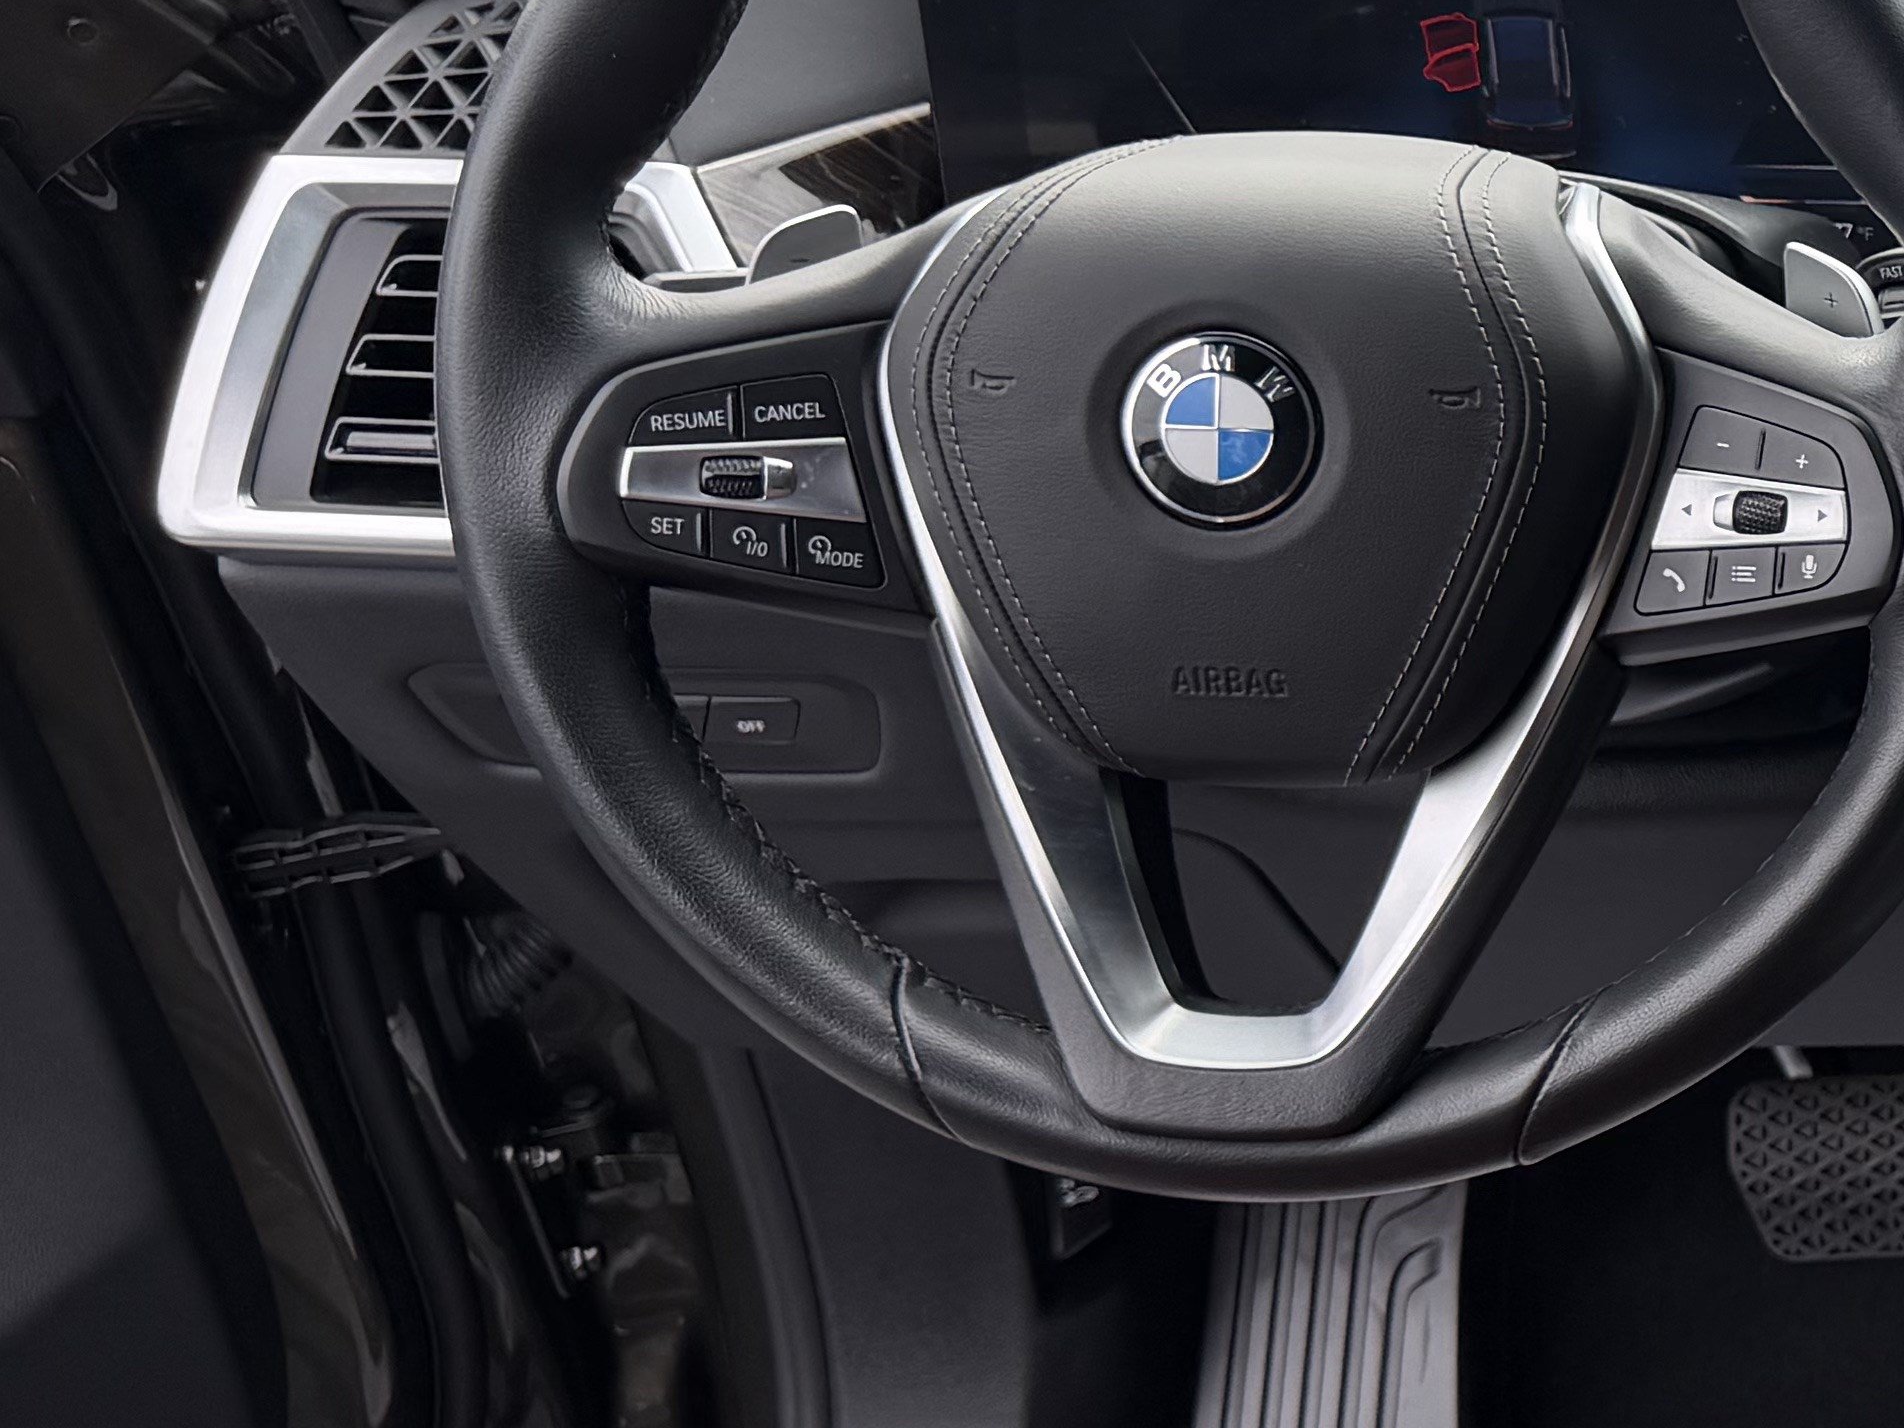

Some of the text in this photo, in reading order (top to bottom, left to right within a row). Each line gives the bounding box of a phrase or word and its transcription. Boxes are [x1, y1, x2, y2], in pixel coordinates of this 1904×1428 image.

[1878, 265, 1903, 280] FAST
[1146, 343, 1296, 404] BMW
[649, 401, 827, 433] RESUME CANCEL
[650, 516, 685, 536] SET
[814, 551, 865, 569] MODE
[1172, 665, 1289, 698] AIRBAG
